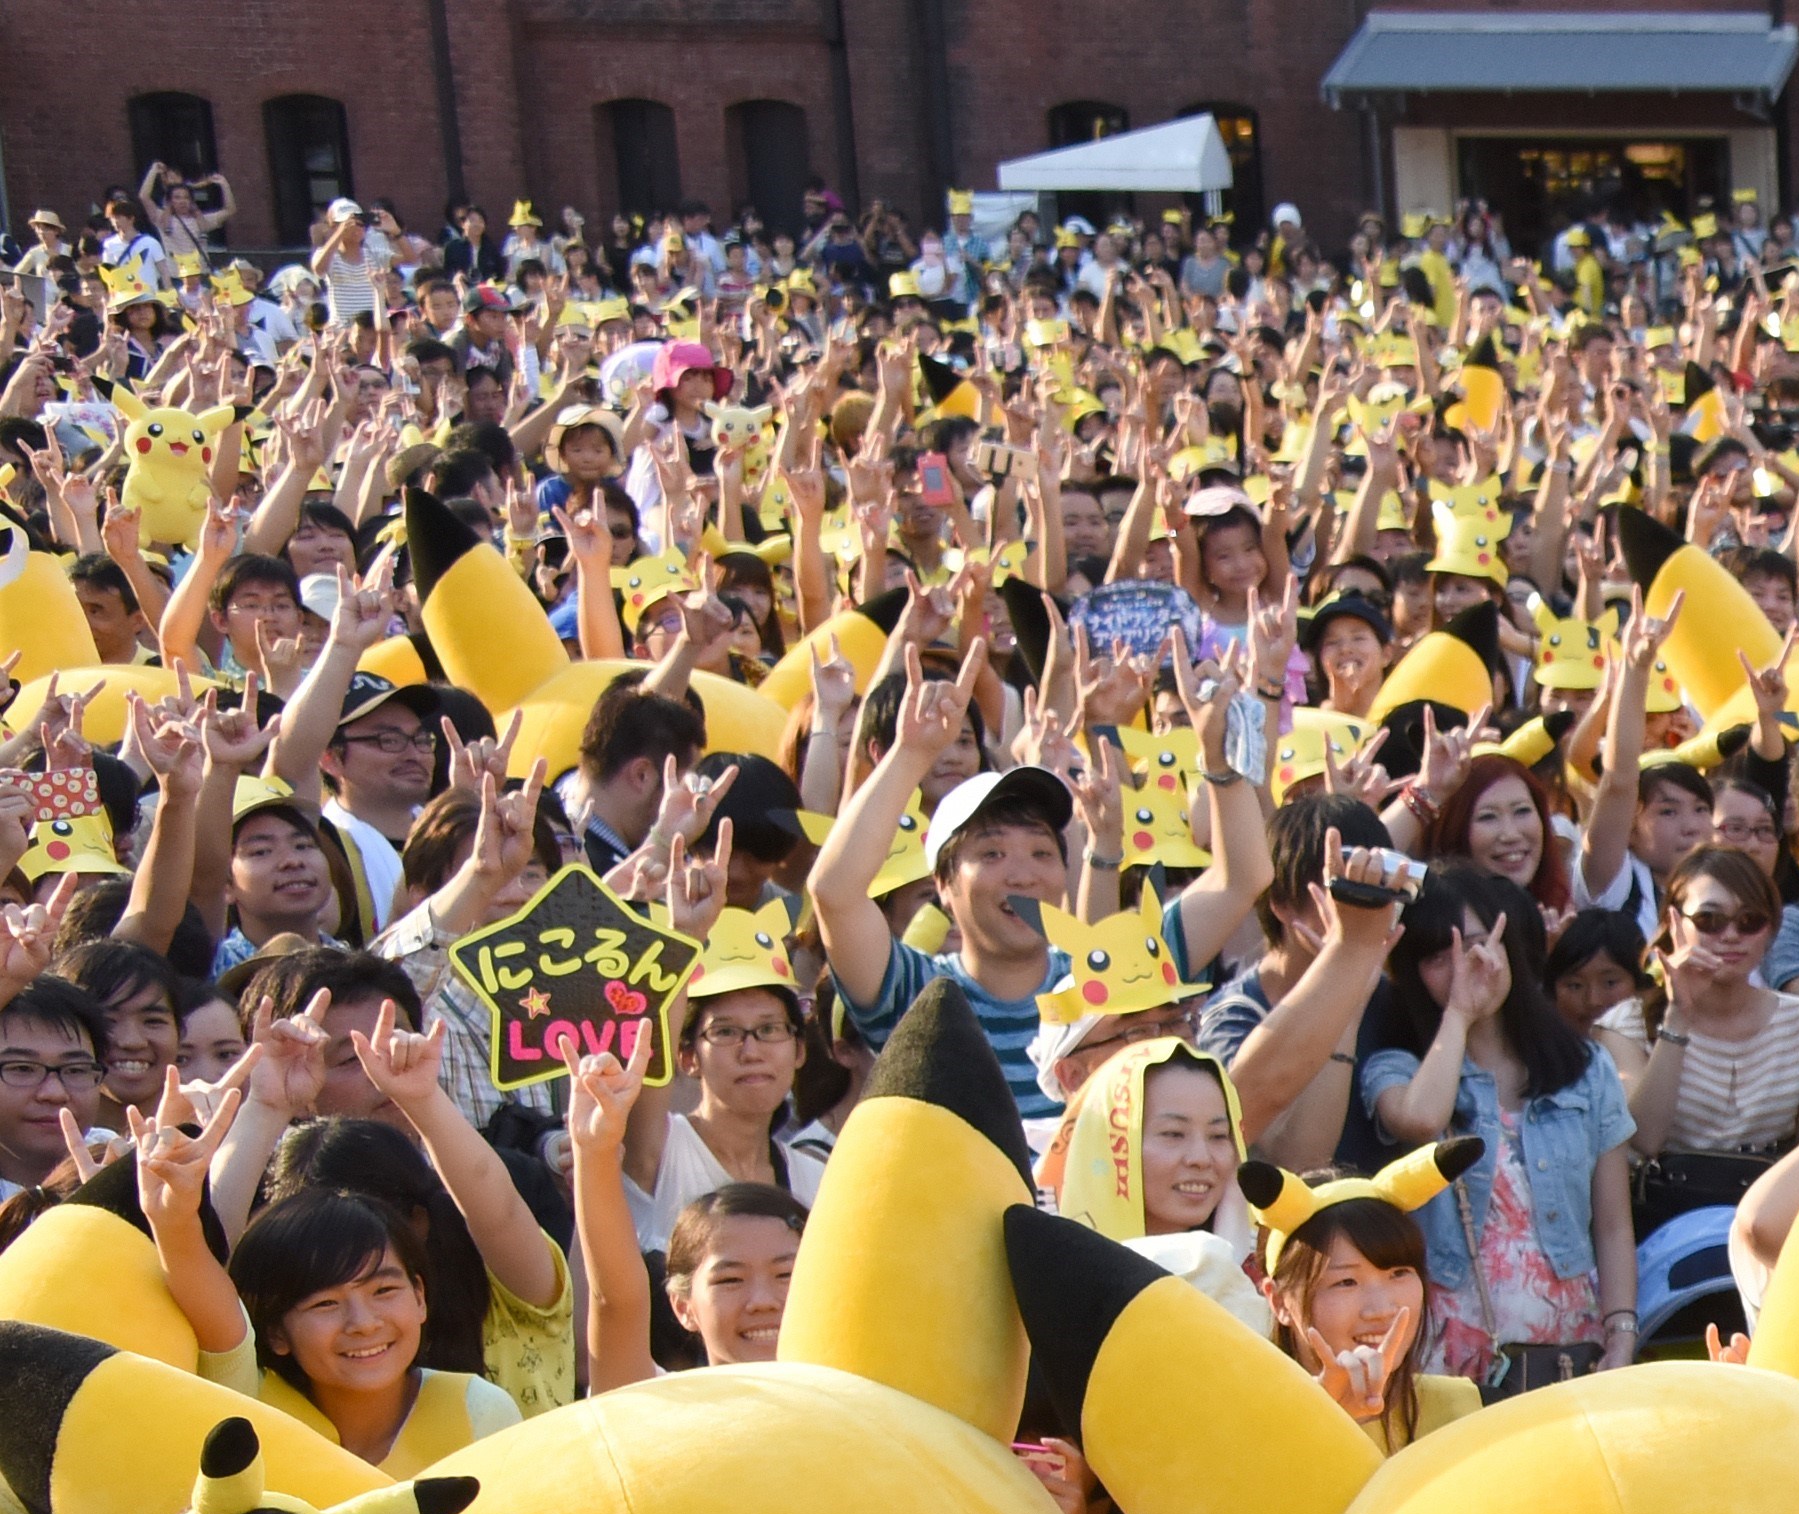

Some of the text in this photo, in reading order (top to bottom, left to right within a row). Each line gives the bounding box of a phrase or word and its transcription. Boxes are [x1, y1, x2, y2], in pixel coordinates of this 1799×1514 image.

[478, 927, 678, 994] にこるん
[508, 1019, 653, 1062] LOVE
